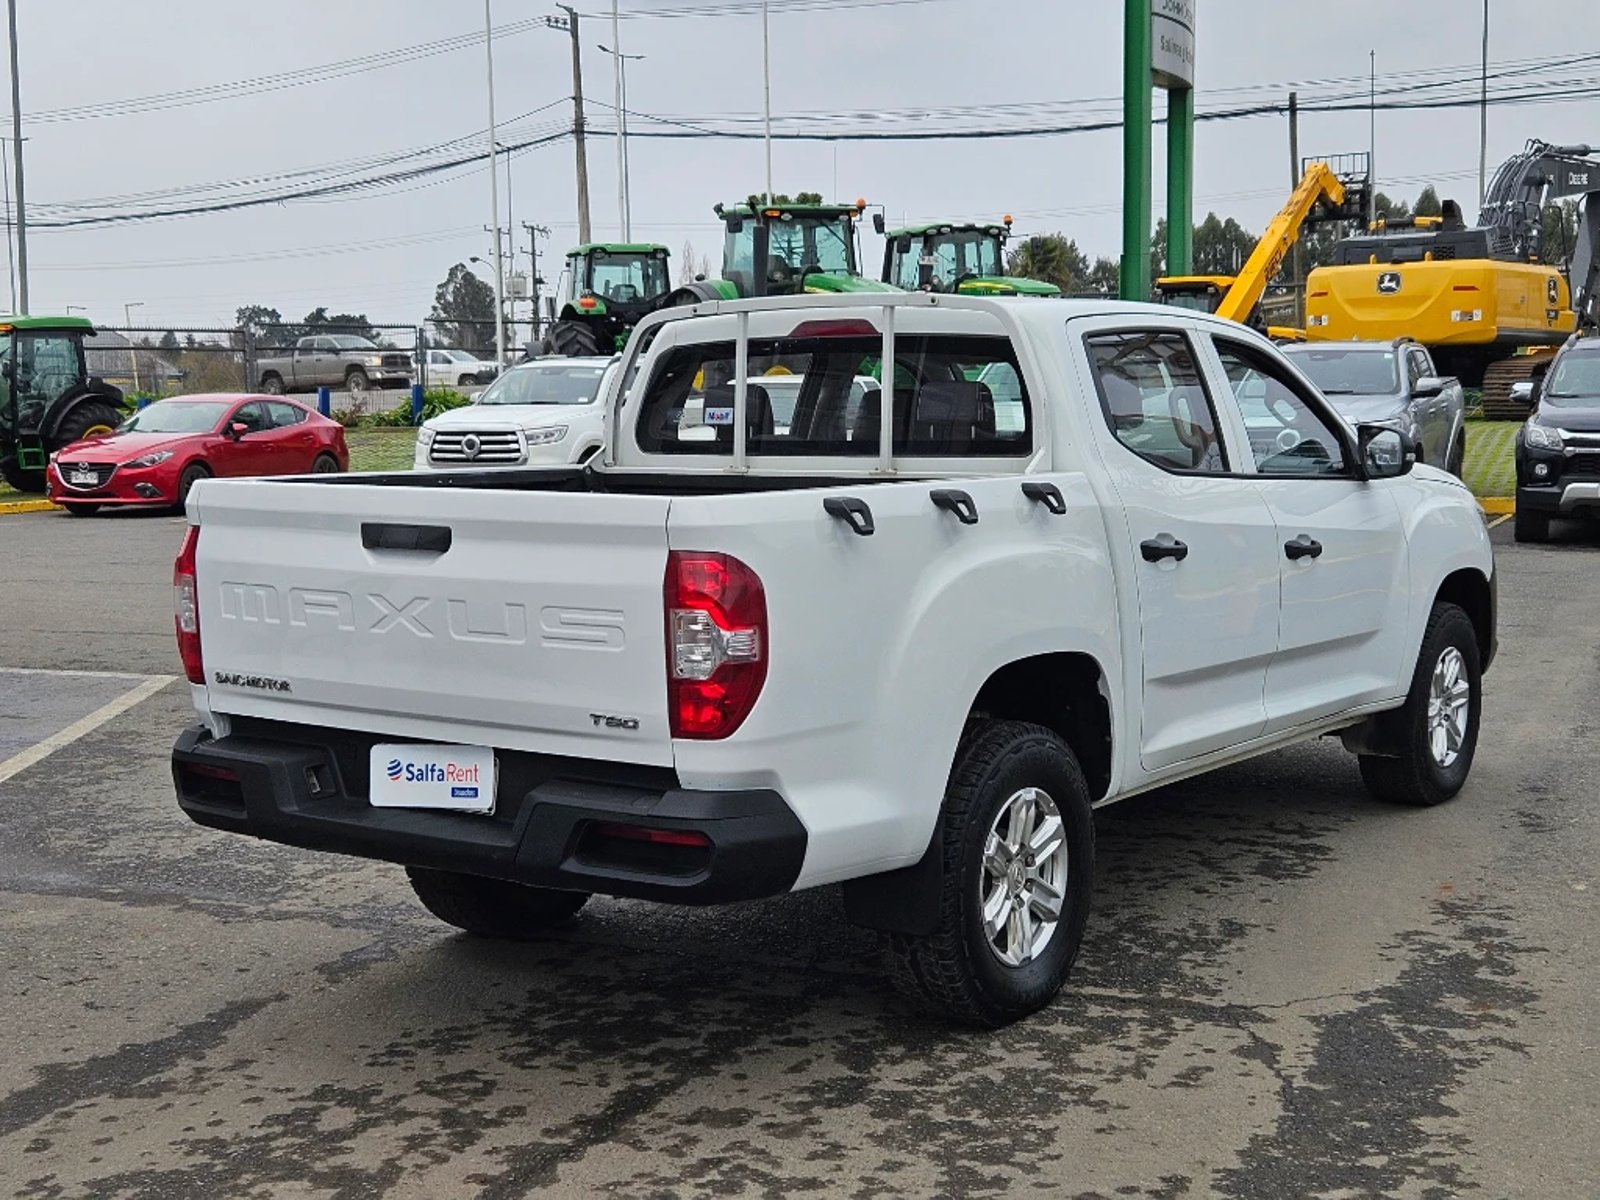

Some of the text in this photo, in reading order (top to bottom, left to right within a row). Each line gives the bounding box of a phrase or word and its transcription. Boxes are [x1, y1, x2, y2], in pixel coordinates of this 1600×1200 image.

[1569, 171, 1589, 185] DEERE
[219, 581, 626, 653] MAXUS
[405, 763, 479, 783] SalfaRent
